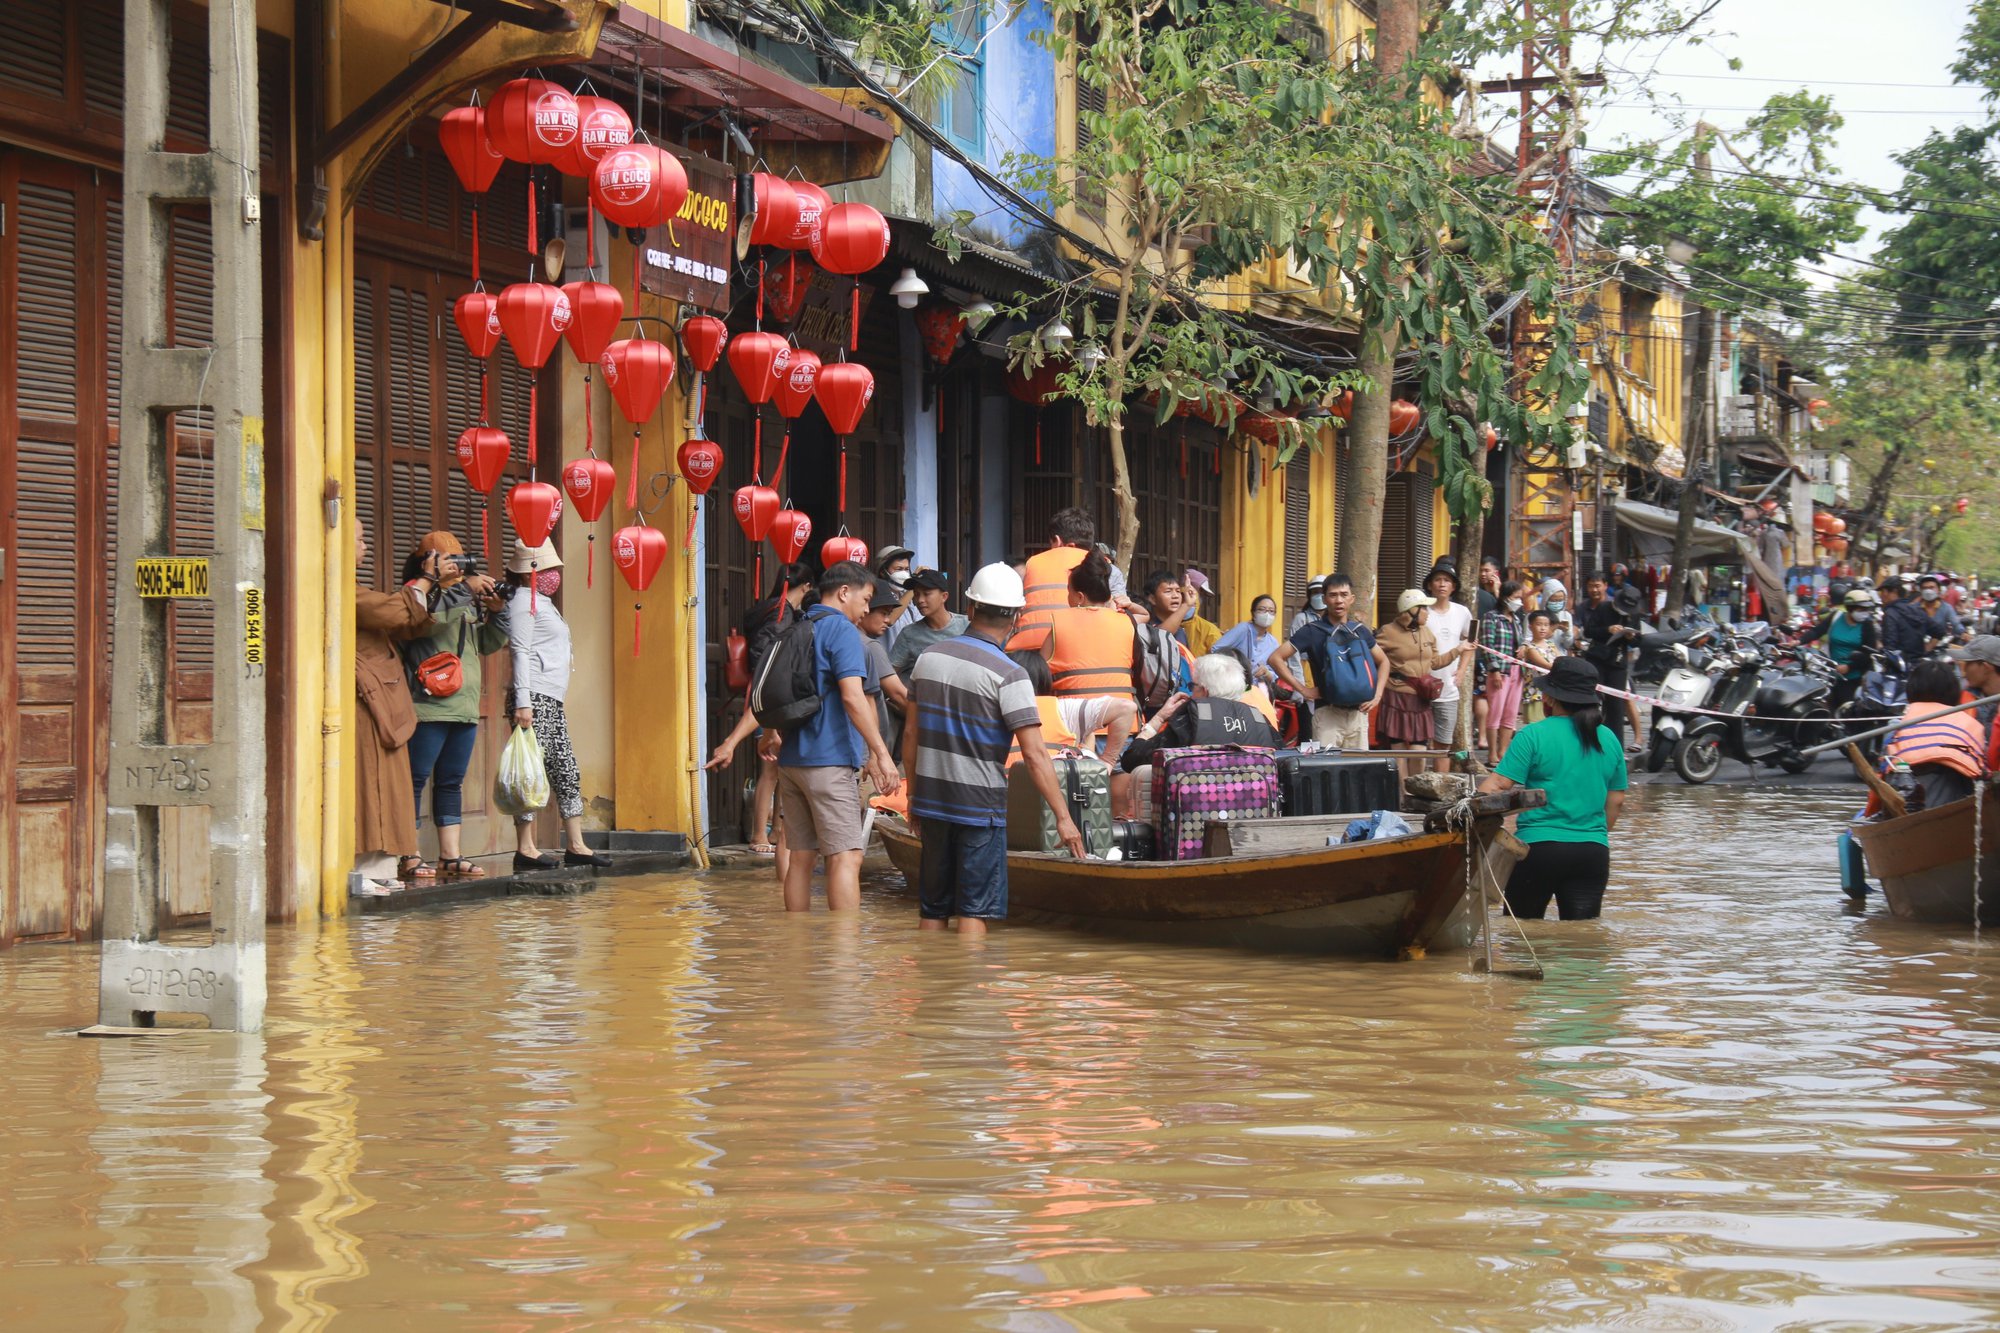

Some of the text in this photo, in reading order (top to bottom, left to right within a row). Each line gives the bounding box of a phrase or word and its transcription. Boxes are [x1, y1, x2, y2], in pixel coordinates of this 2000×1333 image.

[535, 111, 559, 125] RAW
[582, 130, 606, 143] RAW
[600, 169, 651, 187] RAW COCO
[136, 564, 208, 595] 0906.544.100
[247, 589, 259, 616] 0906
[247, 619, 260, 640] 544
[247, 643, 260, 663] 100
